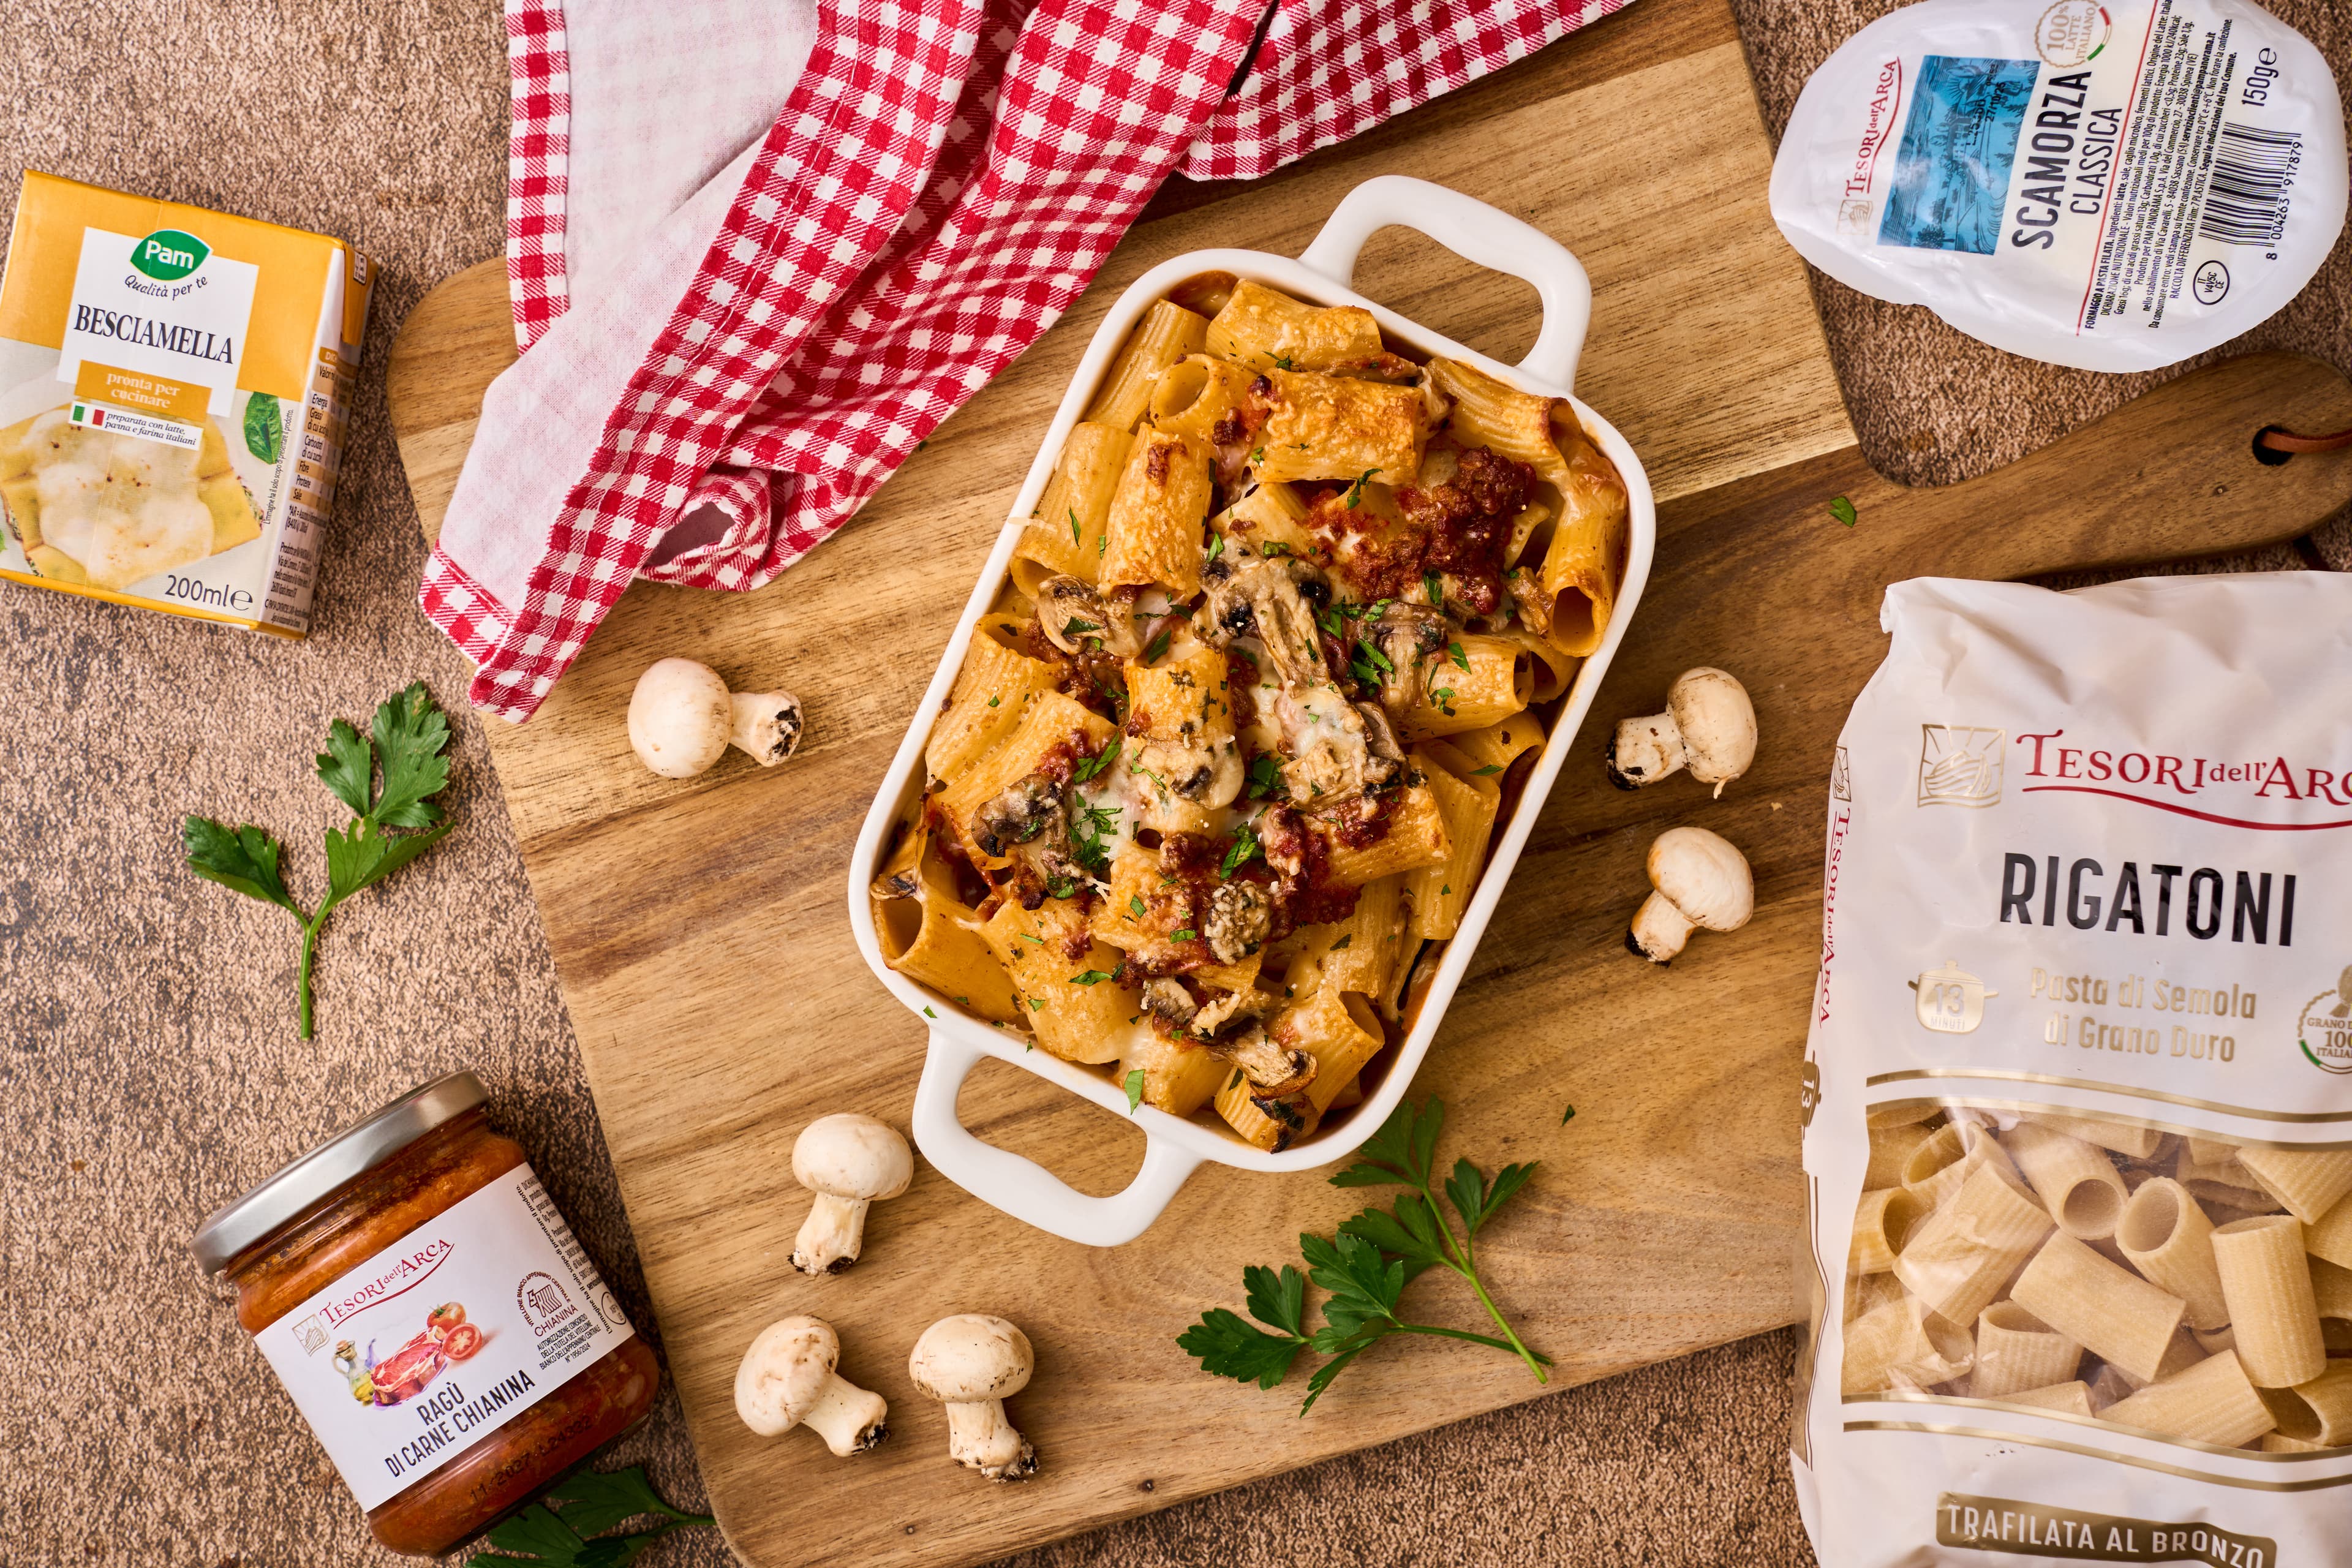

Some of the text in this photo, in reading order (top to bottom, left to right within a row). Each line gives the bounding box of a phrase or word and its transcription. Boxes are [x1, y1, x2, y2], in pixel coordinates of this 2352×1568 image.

[2065, 15, 2081, 50] LATTE
[2076, 7, 2095, 59] ITALIANO
[2155, 15, 2168, 32] Latte:
[2164, 15, 2182, 48] kJ/240kcal;
[2152, 34, 2163, 43] del
[2146, 44, 2161, 66] Origine
[2160, 48, 2172, 62] 1000
[2185, 53, 2198, 66] (VE)
[2221, 52, 2237, 81] Comune.
[2141, 67, 2155, 86] lattici.
[2154, 64, 2169, 86] Energia
[2180, 67, 2194, 87] Spinea
[2182, 32, 2216, 141] servizioclienti@pampanorama.it
[2135, 87, 2150, 113] fermenti
[2176, 88, 2188, 106] 30038
[2215, 94, 2226, 106] del
[2218, 82, 2229, 94] tuo
[2149, 87, 2163, 116] prodotto:
[2128, 115, 2144, 145] microbico,
[2142, 123, 2156, 137] 100g
[2164, 119, 2182, 153] Commercio,
[2205, 107, 2223, 144] indicazioni
[2125, 146, 2136, 165] caglio
[2141, 138, 2150, 149] per
[2177, 142, 2189, 154] (SA)
[2012, 72, 2092, 249] SCAMORZA
[2070, 108, 2122, 214] CLASSICA
[2138, 149, 2147, 165] medi
[2158, 164, 2170, 173] Via
[2162, 154, 2172, 164] del
[2171, 155, 2185, 179] Sassano
[2199, 151, 2212, 171] Segui
[2120, 166, 2132, 180] sale,
[2129, 166, 2143, 202] nutrizionali
[2154, 176, 2167, 193] S.p.A.
[2114, 182, 2128, 200] latte,
[2166, 180, 2179, 198] 84038
[2192, 172, 2207, 202] PLASTICA.
[2271, 198, 2290, 240] 004263
[2283, 141, 2303, 186] 917879
[2106, 201, 2122, 238] Ingredienti:
[2122, 203, 2135, 221] Valori
[2146, 194, 2163, 228] PANORAMA
[2157, 209, 2173, 236] Cavarelli,
[2187, 206, 2199, 221] Film:
[2111, 226, 2130, 270] NUTRIZIONALE
[2143, 230, 2154, 244] PAM
[2155, 238, 2165, 246] Via
[2176, 222, 2195, 266] DIFFERENZIATA
[145, 240, 194, 269] Pam
[2100, 239, 2114, 263] FILATA.
[2143, 245, 2151, 256] per
[2096, 265, 2109, 286] PASTA
[2134, 257, 2148, 284] Prodotto
[2146, 255, 2161, 295] stabilimento
[2169, 268, 2185, 298] RACCOLTA
[2204, 271, 2217, 293] V4V5C
[124, 274, 208, 301] Qualità per te
[2100, 272, 2120, 315] DICHIARAZIONE
[2215, 279, 2225, 289] CE
[2085, 293, 2103, 328] FORMAGGIO
[2143, 296, 2153, 311] nello
[74, 304, 233, 364] BESCIAMELLA
[106, 373, 181, 400] pronta per
[111, 387, 171, 409] cucinare
[107, 413, 186, 435] preparata con latte,
[137, 426, 164, 439] farina
[166, 432, 197, 445] italiani
[2000, 852, 2297, 947] RIGATONI
[1934, 982, 1965, 1017] 13
[2030, 968, 2257, 1019] Pasta di Semola
[1931, 1016, 1965, 1030] MINUTI
[2307, 1017, 2345, 1029] GRANO
[2044, 1011, 2236, 1063] di Grano Duro
[2316, 1046, 2352, 1058] ITALIA
[1801, 1080, 1814, 1108] 13
[516, 1185, 535, 1212] prodotto.
[536, 1218, 559, 1249] presentare
[526, 1271, 551, 1281] APPENNINO
[561, 1256, 574, 1273] scopo
[517, 1279, 527, 1297] BIANCO
[551, 1278, 571, 1303] CENTRALE
[573, 1273, 582, 1286] solo
[518, 1299, 535, 1327] VITELLONE
[534, 1304, 579, 1337] CHIANINA
[590, 1299, 613, 1334] L'immagine
[537, 1313, 589, 1351] AUTORIZZAZIONE CONSORZIO
[540, 1320, 593, 1359] DELLA TUTELA DEL VITELLONE
[539, 1324, 601, 1370] BIANCO DELL'APPENNINO CENTRALE
[571, 1343, 592, 1359] 1956/2024
[417, 1381, 465, 1426] RAGÙ
[384, 1370, 536, 1477] DI CARNE CHIANINA
[1947, 1504, 2264, 1568] TRAFILATA AL BRONZO
